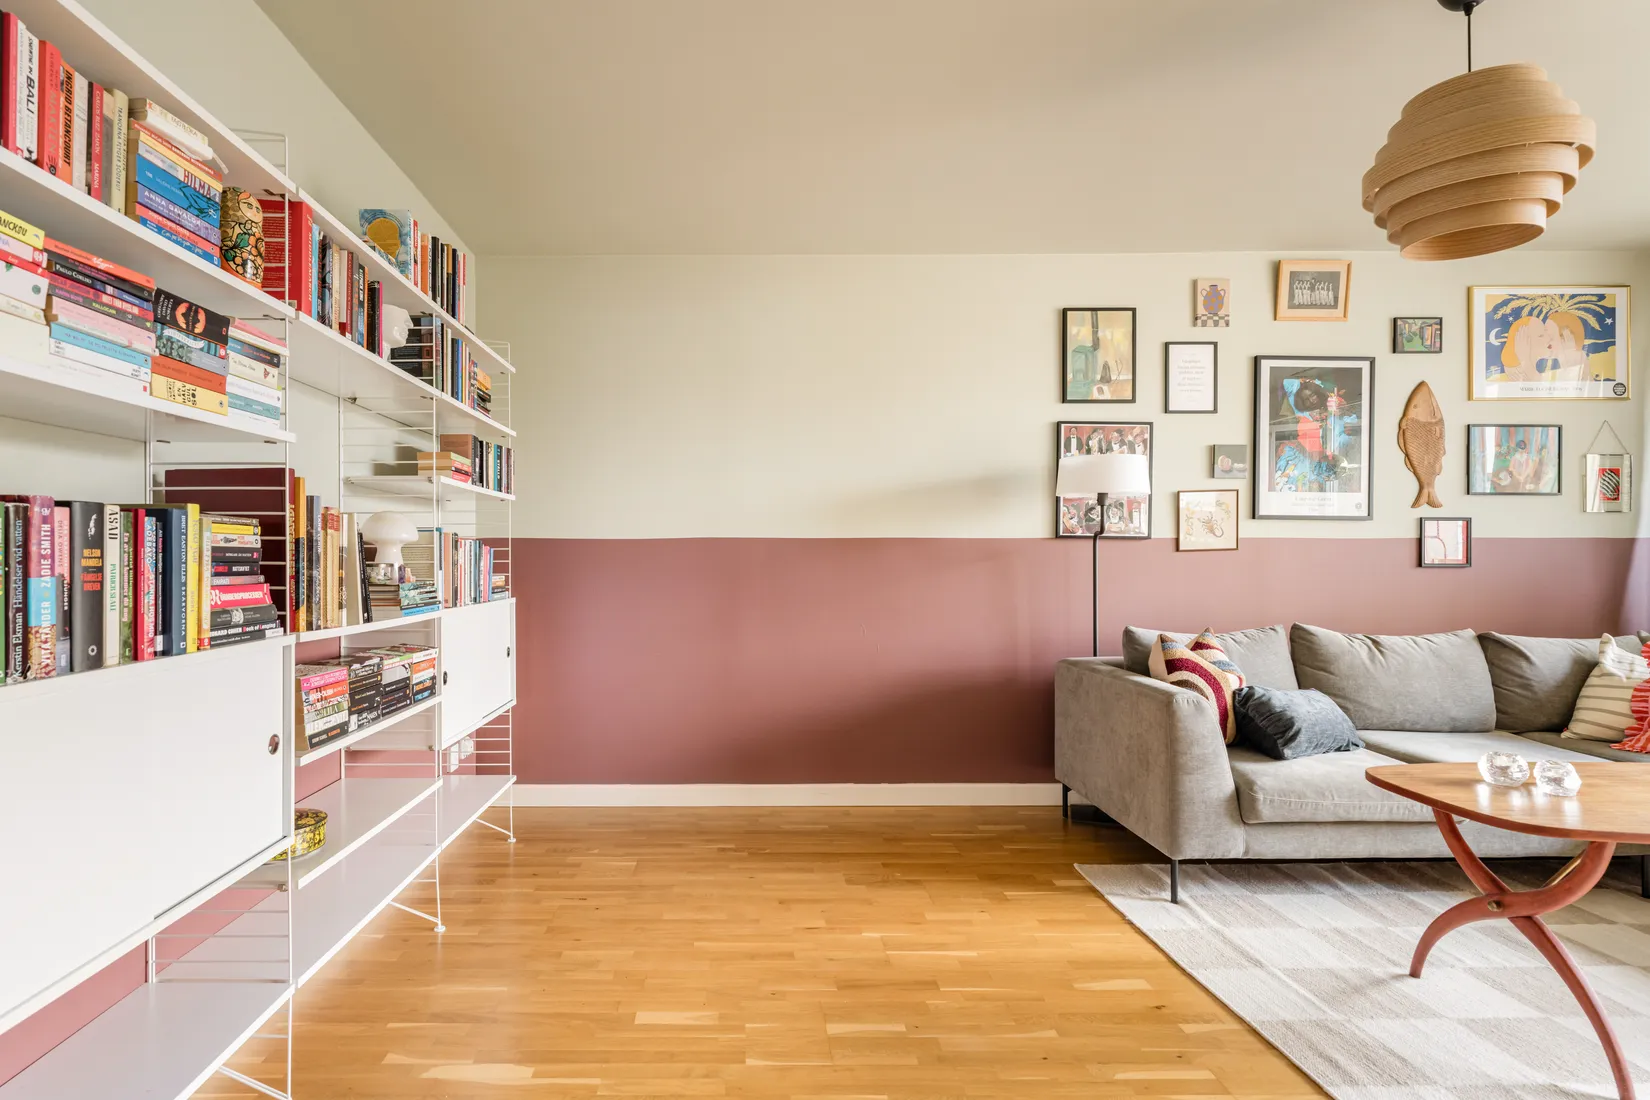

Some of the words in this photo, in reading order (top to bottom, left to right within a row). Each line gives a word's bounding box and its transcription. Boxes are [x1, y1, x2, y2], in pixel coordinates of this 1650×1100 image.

[26, 75, 35, 114] BALI
[48, 90, 57, 154] MAKTEN
[64, 104, 72, 167] BETANCOURT
[184, 169, 211, 198] HILMA
[144, 190, 166, 206] ANNA
[168, 203, 200, 226] GAVALDA
[56, 264, 72, 275] PAULO
[73, 271, 92, 284] COELHO
[92, 302, 117, 315] KALLOCAIN
[14, 520, 23, 546] vatten
[41, 524, 51, 555] SMITH
[108, 509, 119, 540] ASAD
[124, 532, 129, 542] En
[13, 548, 22, 561] vid
[81, 558, 102, 567] MANDELA
[124, 544, 129, 553] av
[13, 564, 23, 608] Händelser
[41, 559, 51, 588] ZADIE
[13, 612, 23, 643] Ekman
[40, 602, 51, 639] TÄNDER
[13, 646, 23, 677] Kerstin
[41, 642, 51, 665] VITA
